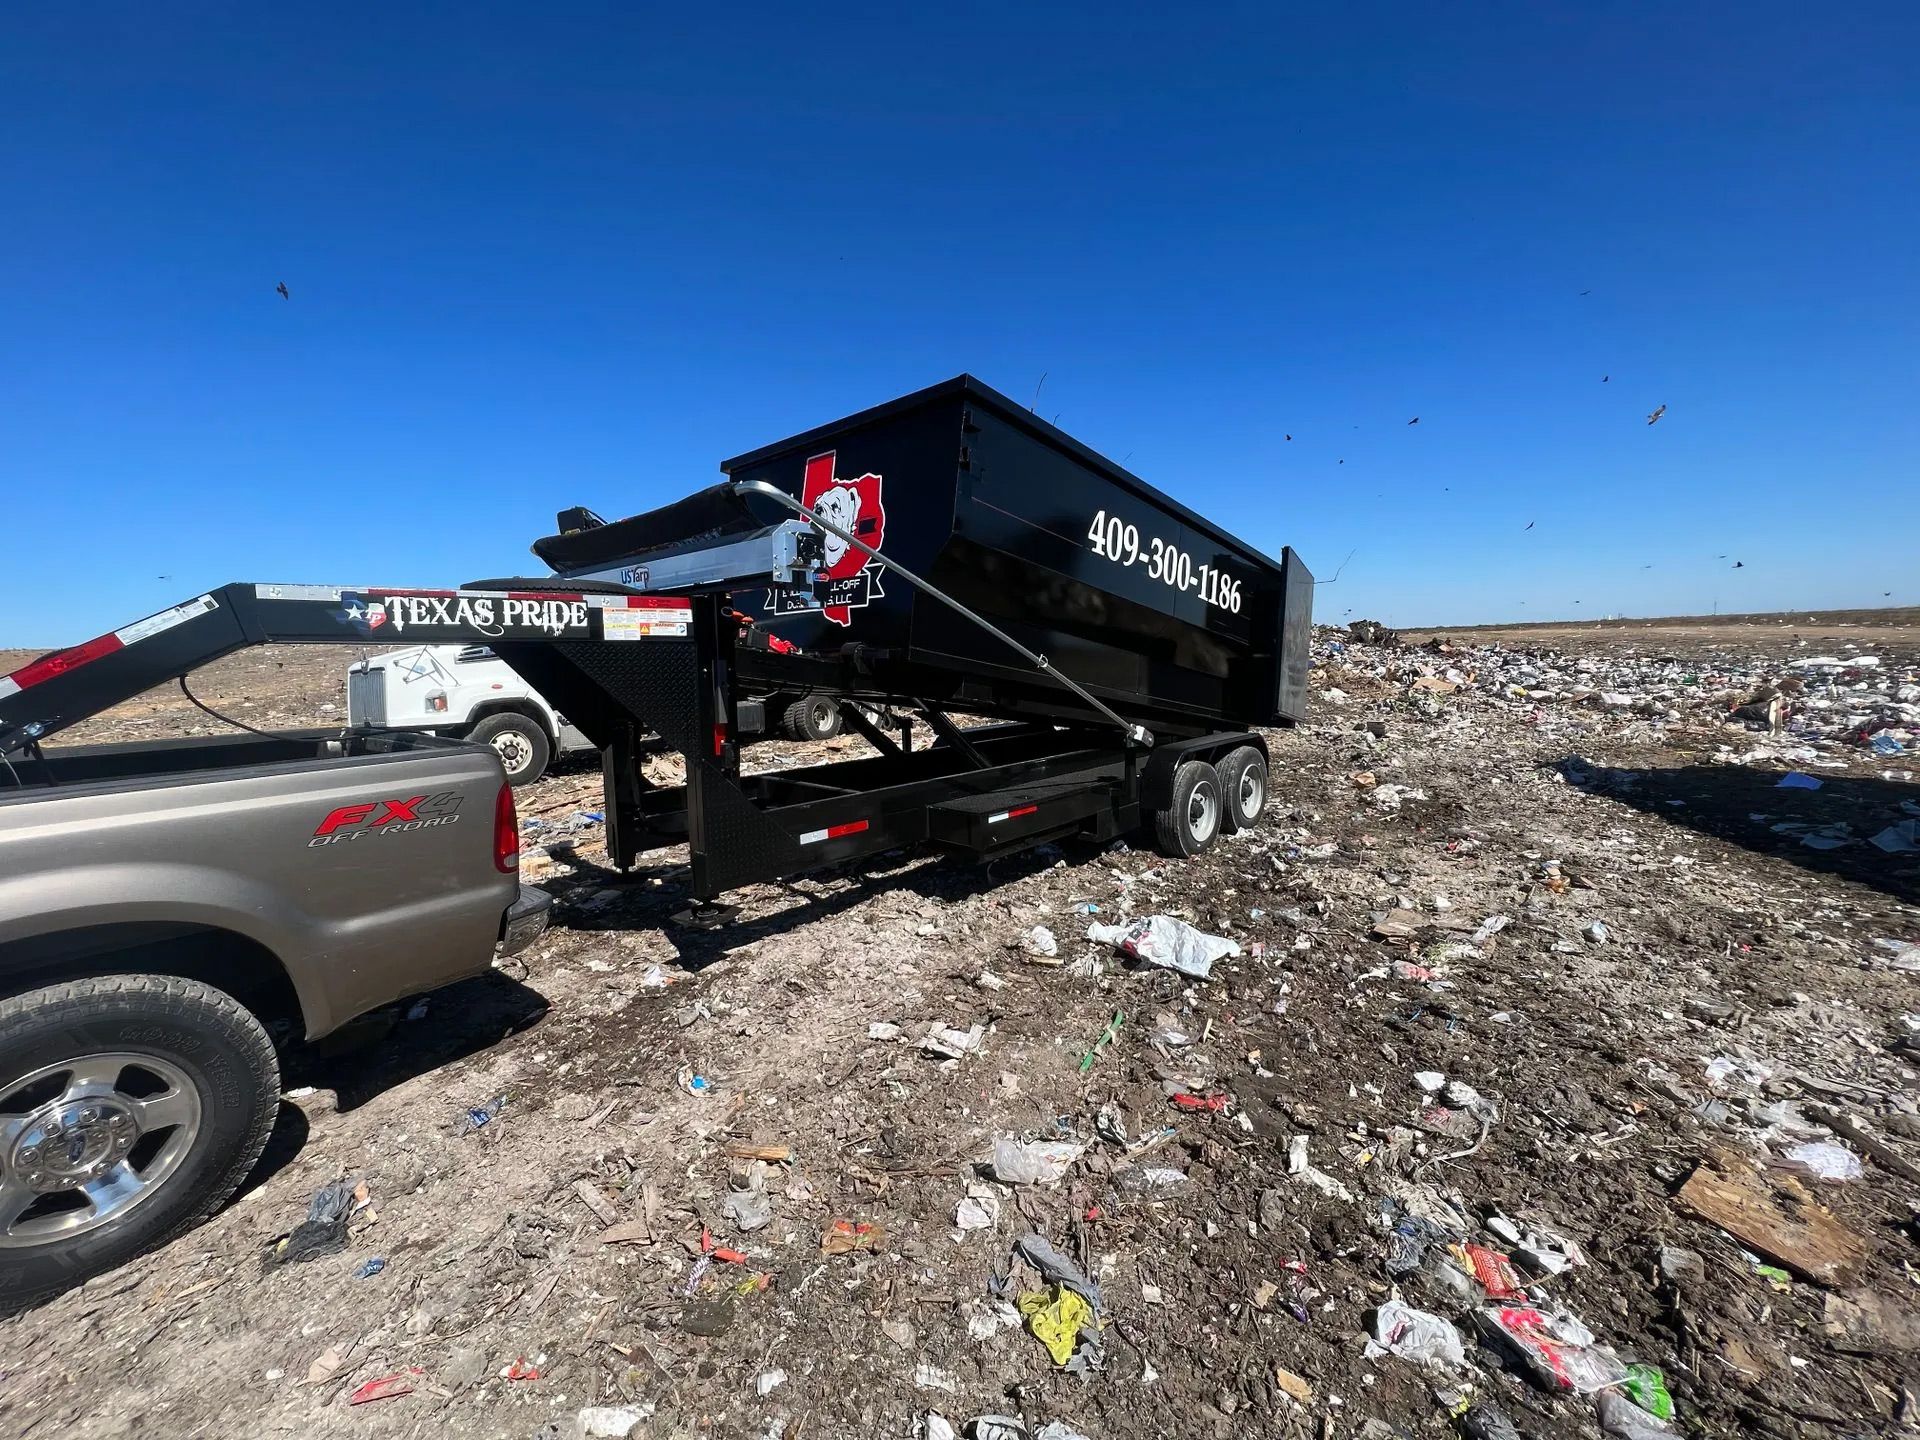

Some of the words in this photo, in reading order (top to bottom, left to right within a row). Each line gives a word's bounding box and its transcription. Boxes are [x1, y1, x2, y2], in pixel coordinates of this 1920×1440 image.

[1088, 510, 1242, 614] 409-300-1186
[384, 597, 504, 636] TEXAS
[502, 599, 588, 636] PRIDE
[835, 593, 852, 604] LLC
[307, 828, 373, 848] OFF
[378, 814, 461, 836] ROAD
[313, 791, 464, 837] FX4
